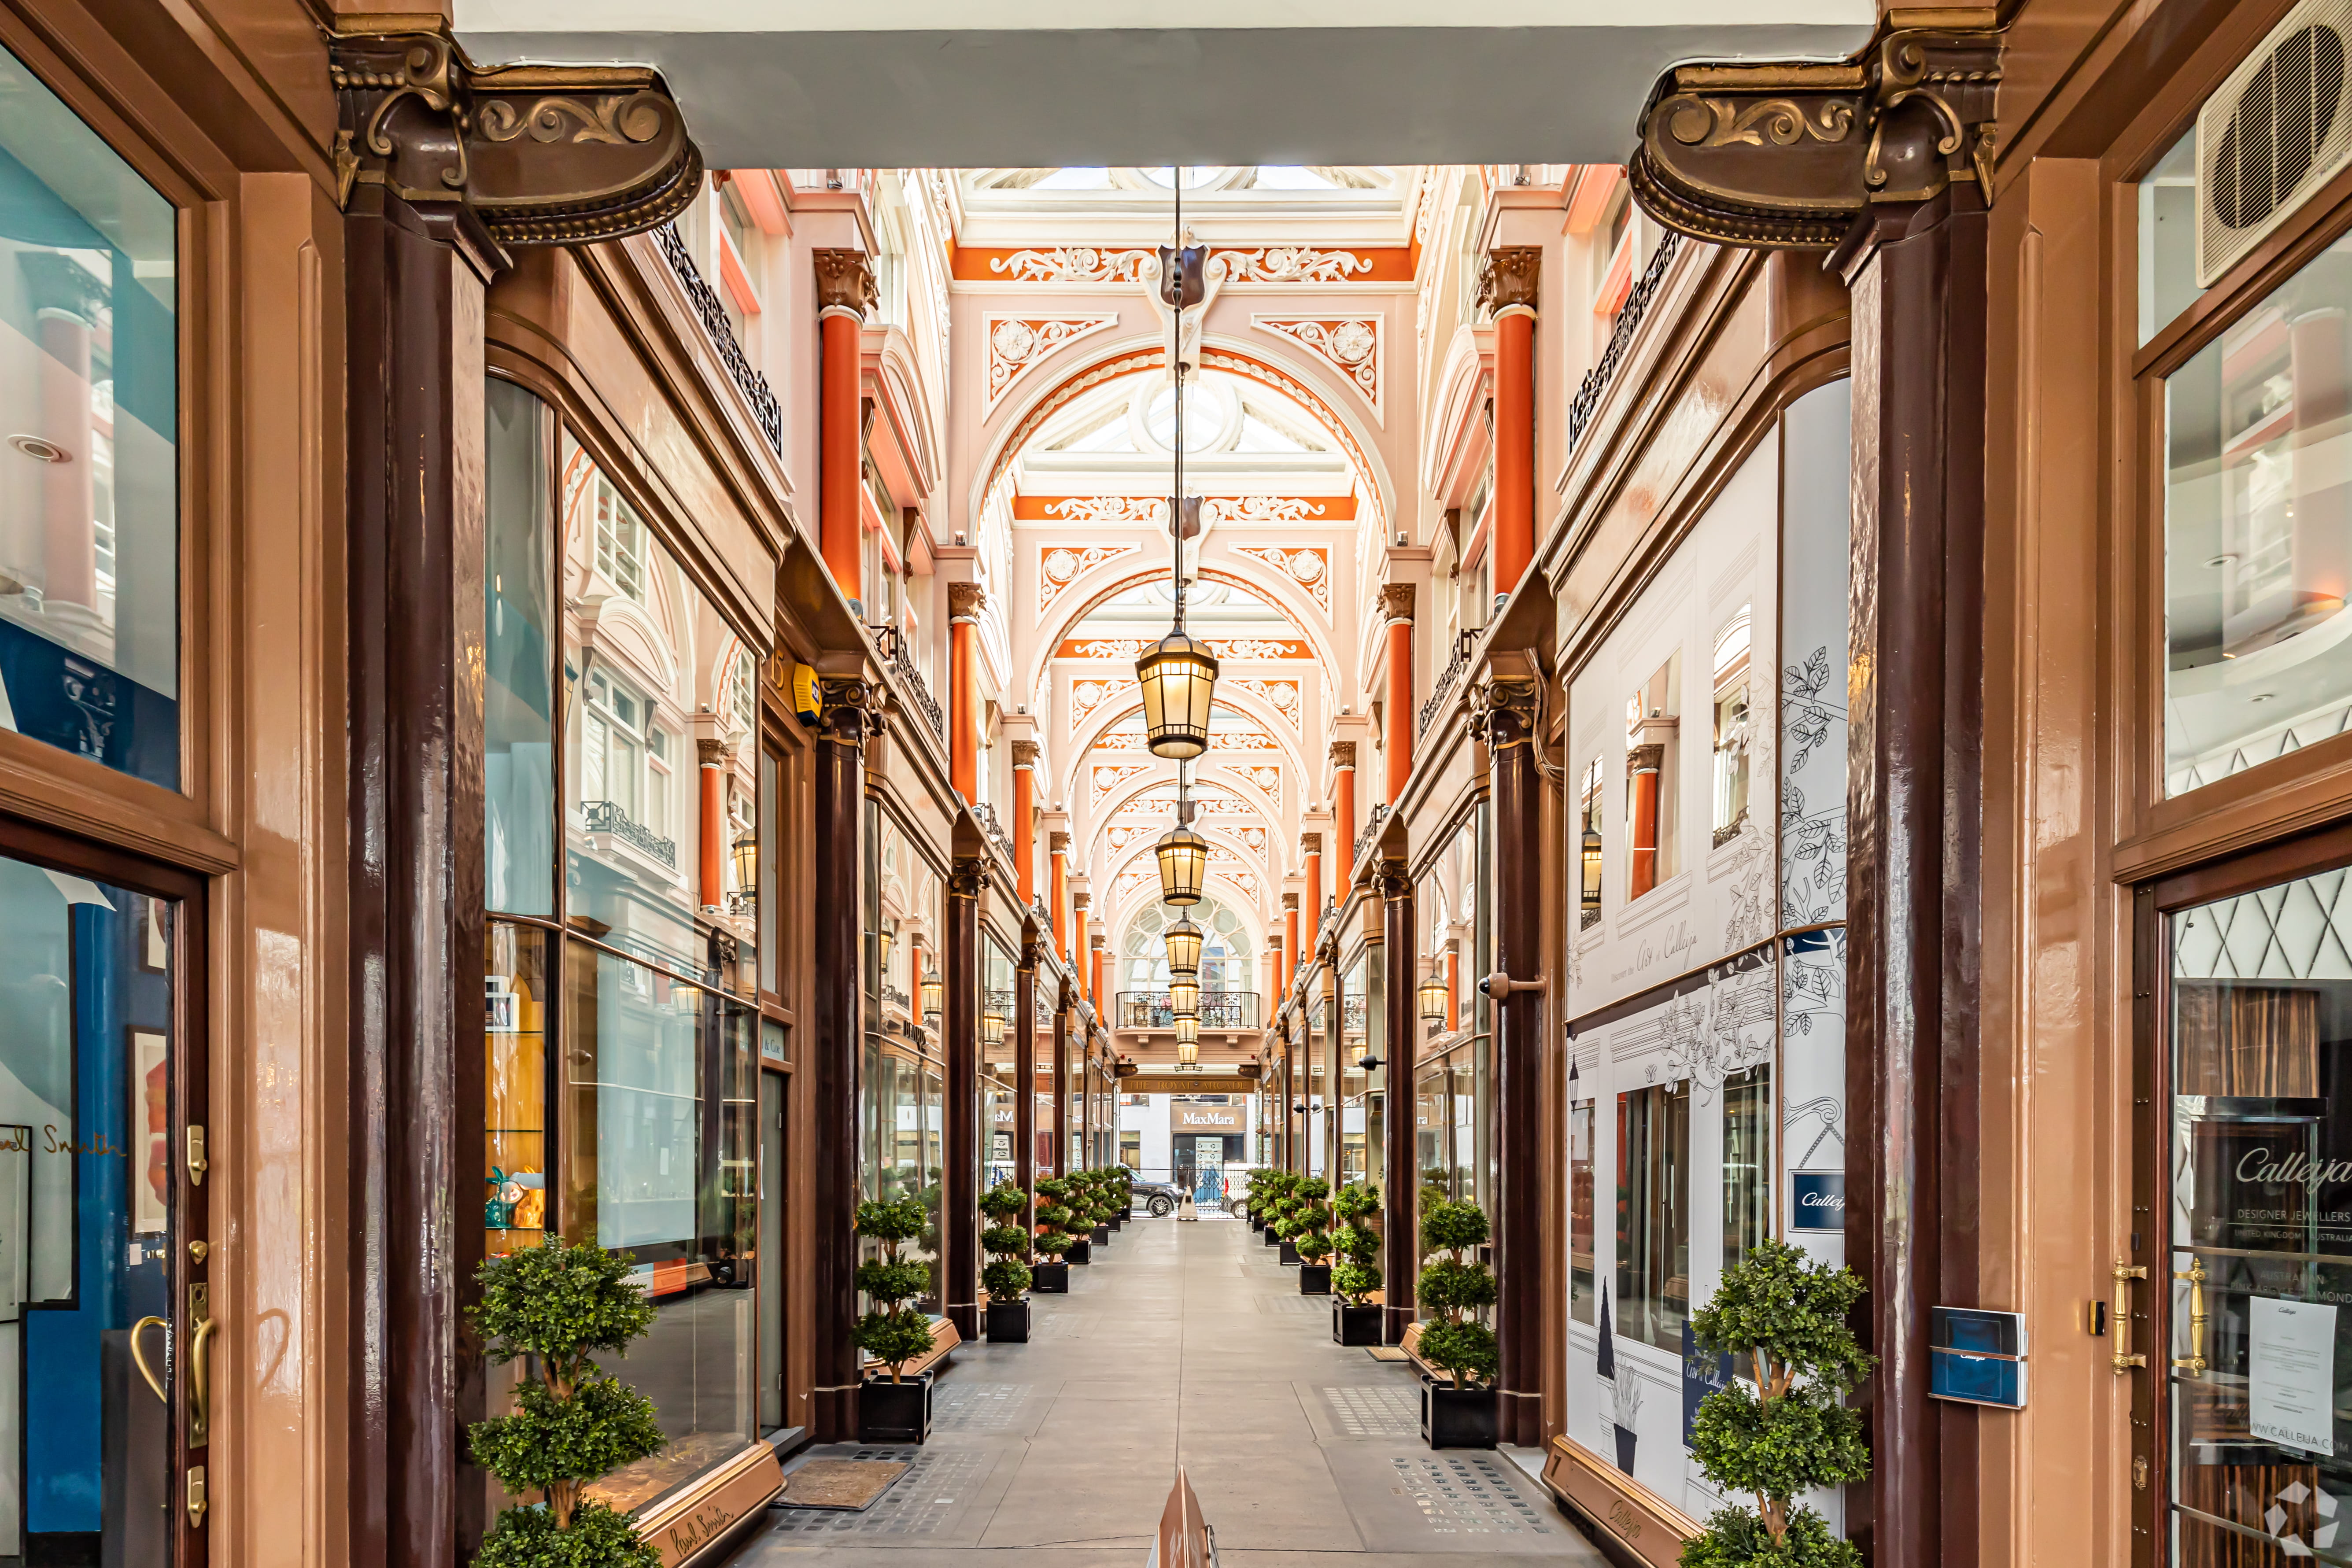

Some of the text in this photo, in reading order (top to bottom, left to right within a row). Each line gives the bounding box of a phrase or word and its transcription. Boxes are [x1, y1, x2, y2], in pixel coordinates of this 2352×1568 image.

[770, 649, 784, 688] 15
[1130, 1081, 1248, 1090] THE ROYAL ARCADE
[1182, 1112, 1234, 1125] MaxMara
[2237, 1209, 2351, 1222] DESIGNER JEWELLERS
[2234, 1229, 2261, 1238] UNITED
[2263, 1231, 2301, 1240] KINGDOM
[2230, 1282, 2251, 1291] PINK
[1550, 1454, 1562, 1477] 7
[670, 1505, 734, 1558] Paul Smith
